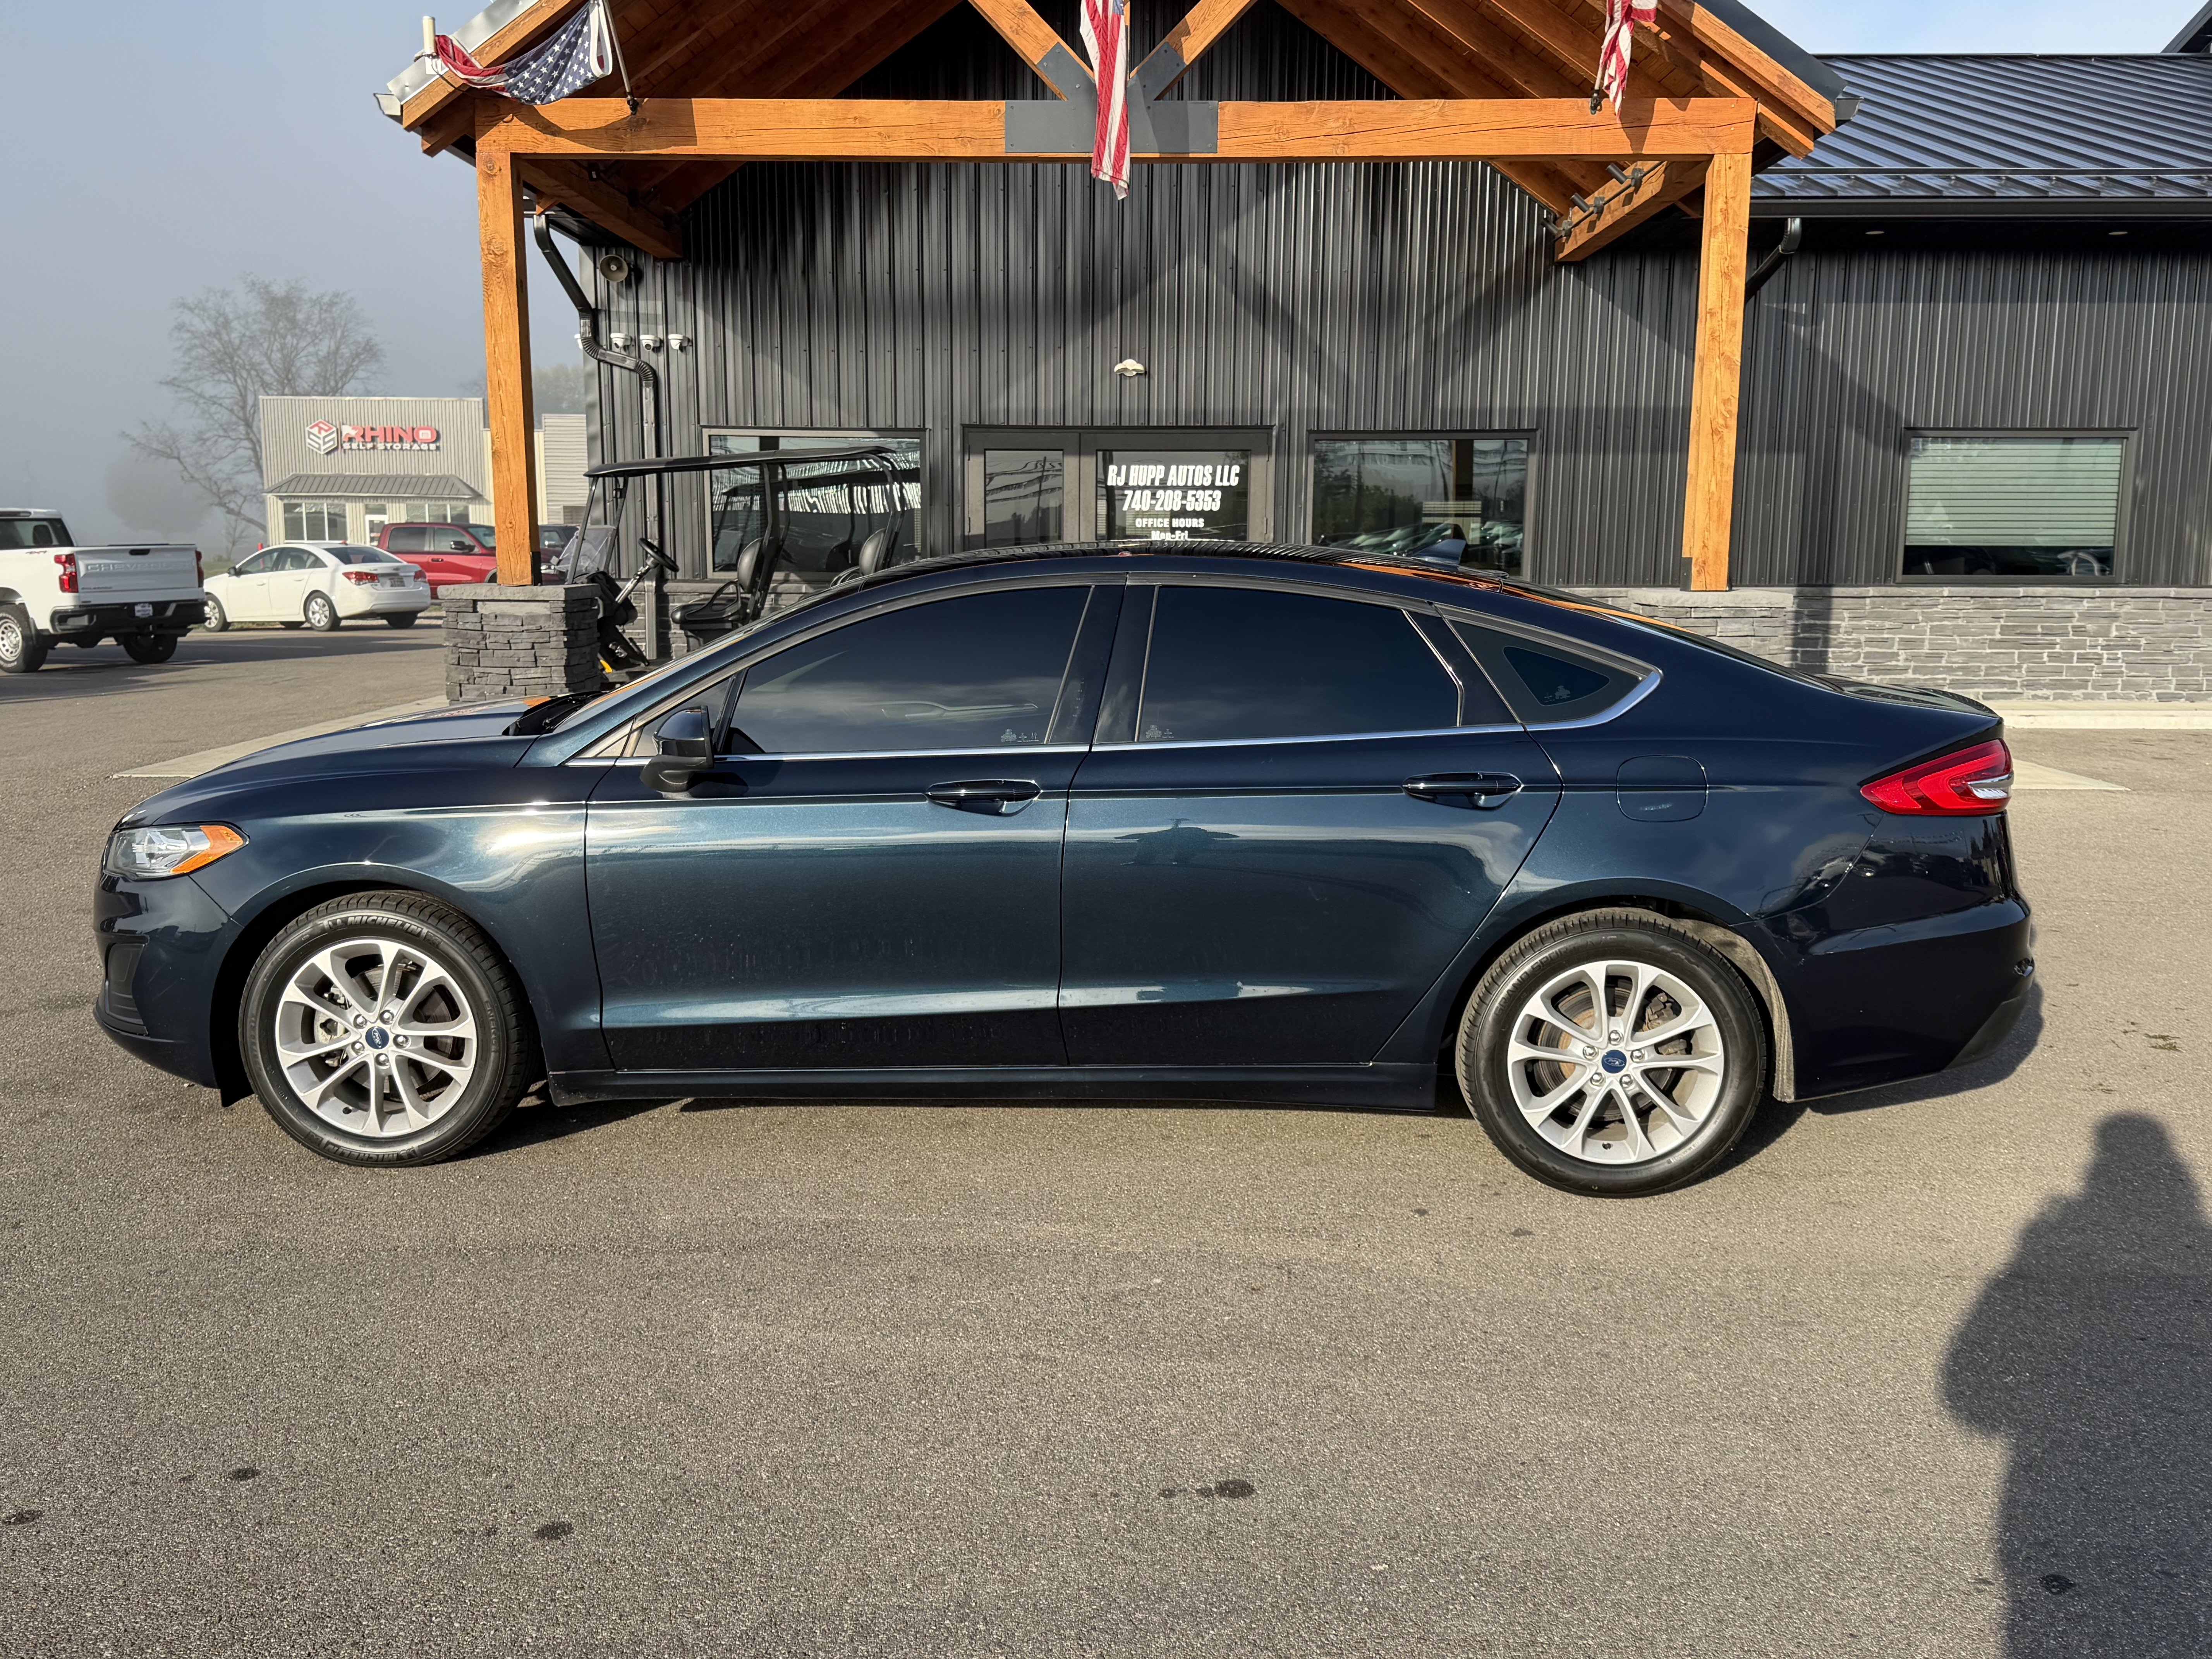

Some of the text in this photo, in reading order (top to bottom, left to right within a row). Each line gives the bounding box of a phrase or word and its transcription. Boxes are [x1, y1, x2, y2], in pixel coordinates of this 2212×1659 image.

[342, 425, 437, 443] RHINO
[1107, 465, 1240, 486] RJ HUPP AUTOS LLC
[1122, 490, 1222, 511] 740-208-5353
[1135, 518, 1205, 528] OFFICE HOURS
[1151, 531, 1188, 541] Mon-Fri
[348, 915, 422, 936] MICHELIN
[1493, 971, 1530, 1016] GRAND
